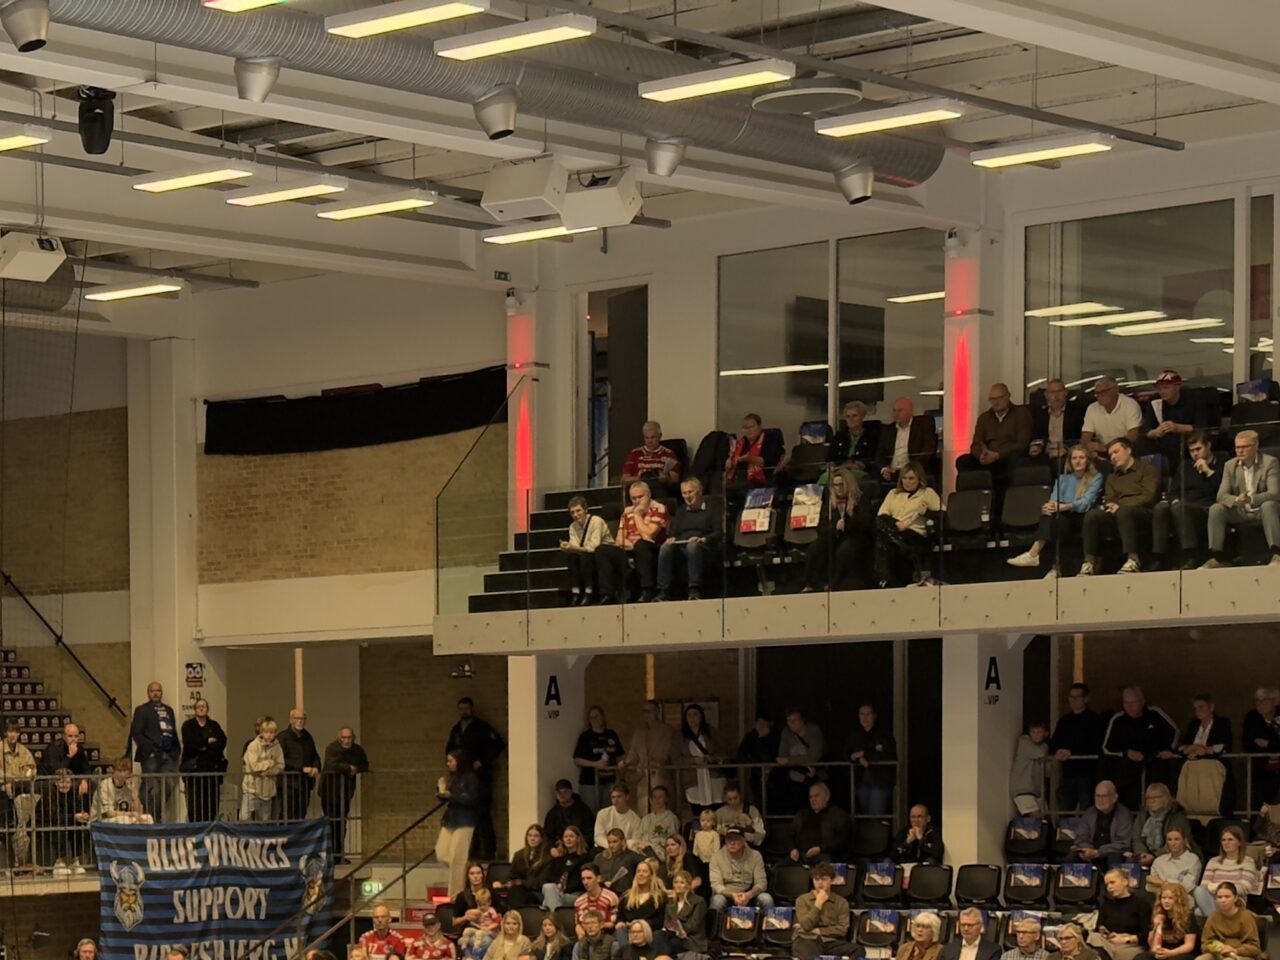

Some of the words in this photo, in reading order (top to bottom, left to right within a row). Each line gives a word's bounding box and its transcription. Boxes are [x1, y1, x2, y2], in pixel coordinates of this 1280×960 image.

[545, 676, 562, 706] A
[985, 656, 1001, 690] A
[146, 836, 200, 872] BLUE
[204, 833, 292, 870] VIKINGS
[173, 886, 271, 924] SUPPORT
